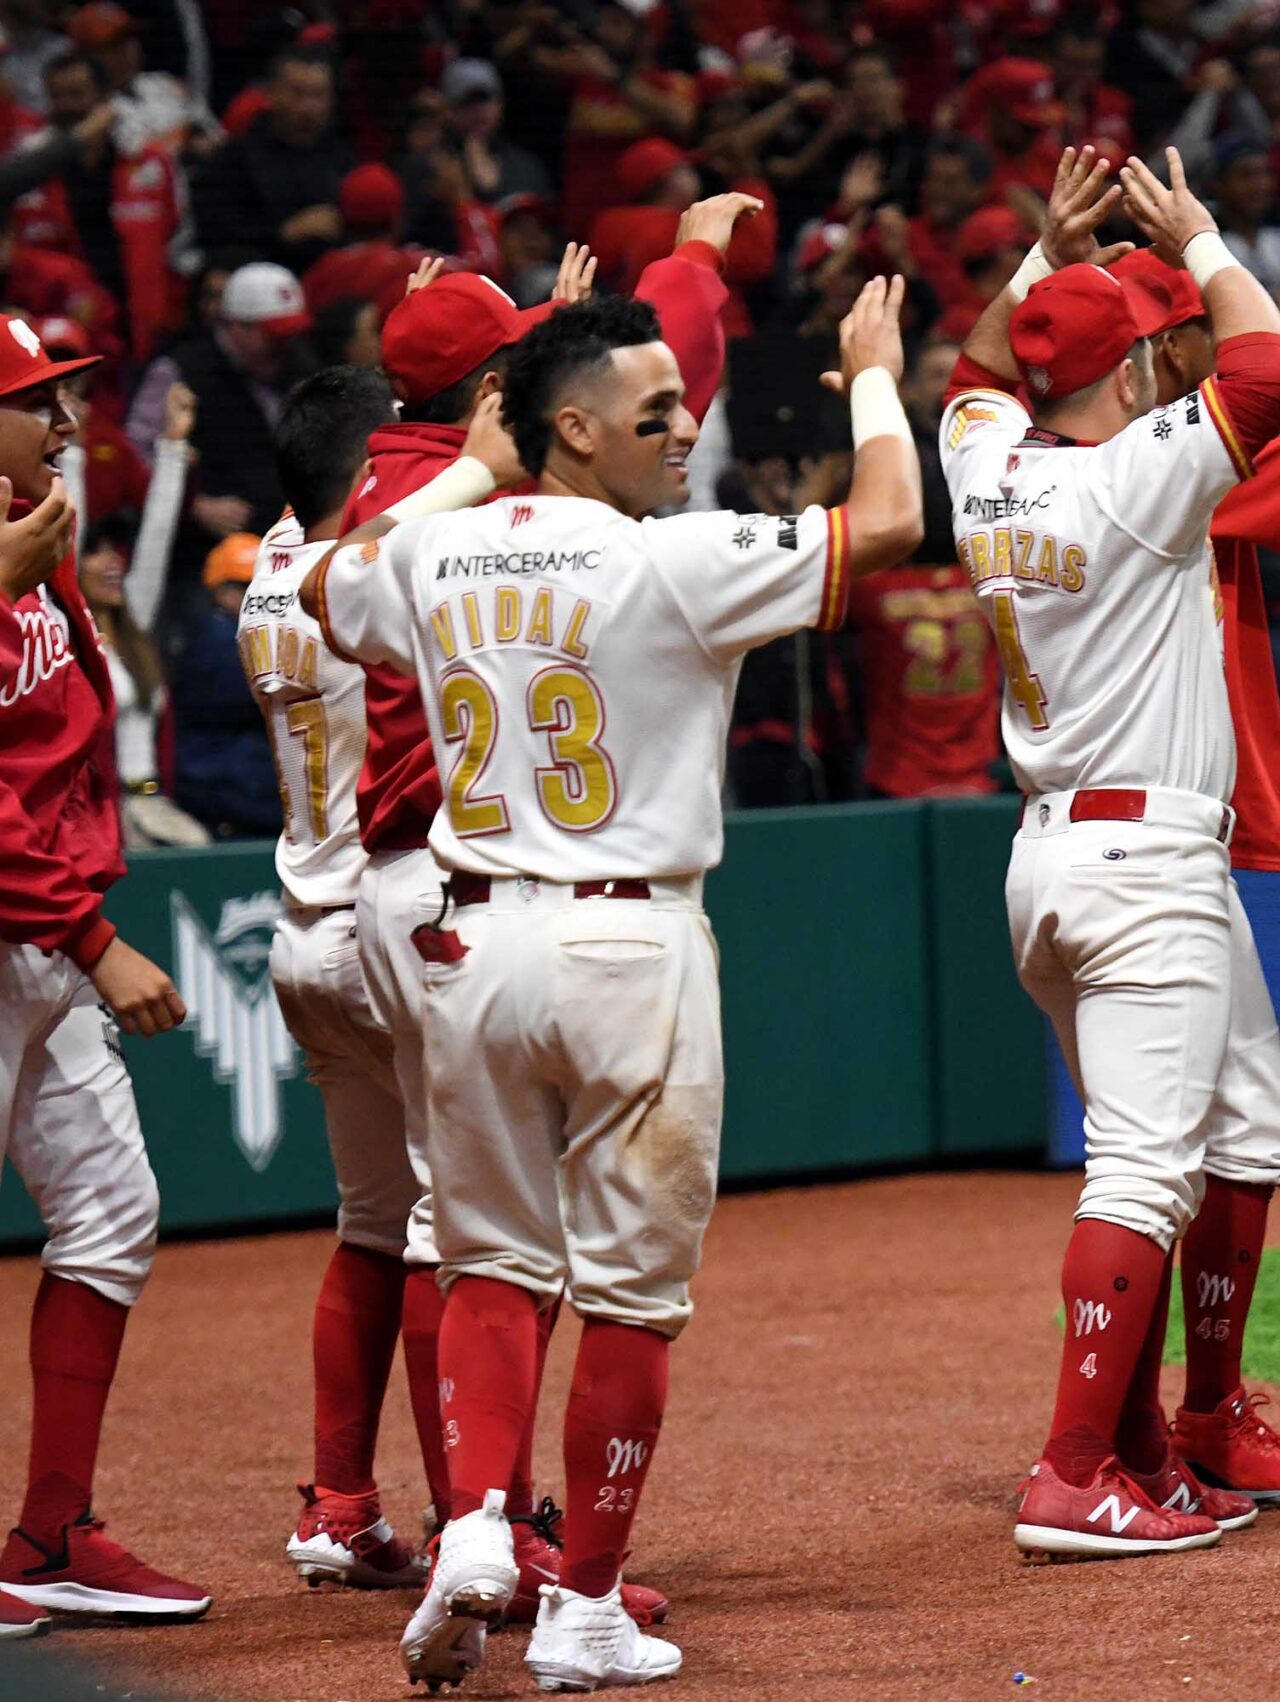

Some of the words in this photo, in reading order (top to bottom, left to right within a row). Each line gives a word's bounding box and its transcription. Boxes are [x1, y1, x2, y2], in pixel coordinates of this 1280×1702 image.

[451, 550, 600, 578] INTERCERAMIC
[430, 586, 592, 662] VIDAL
[438, 665, 619, 840] 23
[1079, 1352, 1098, 1379] 4
[593, 1485, 635, 1514] 23
[1087, 1494, 1141, 1534] N
